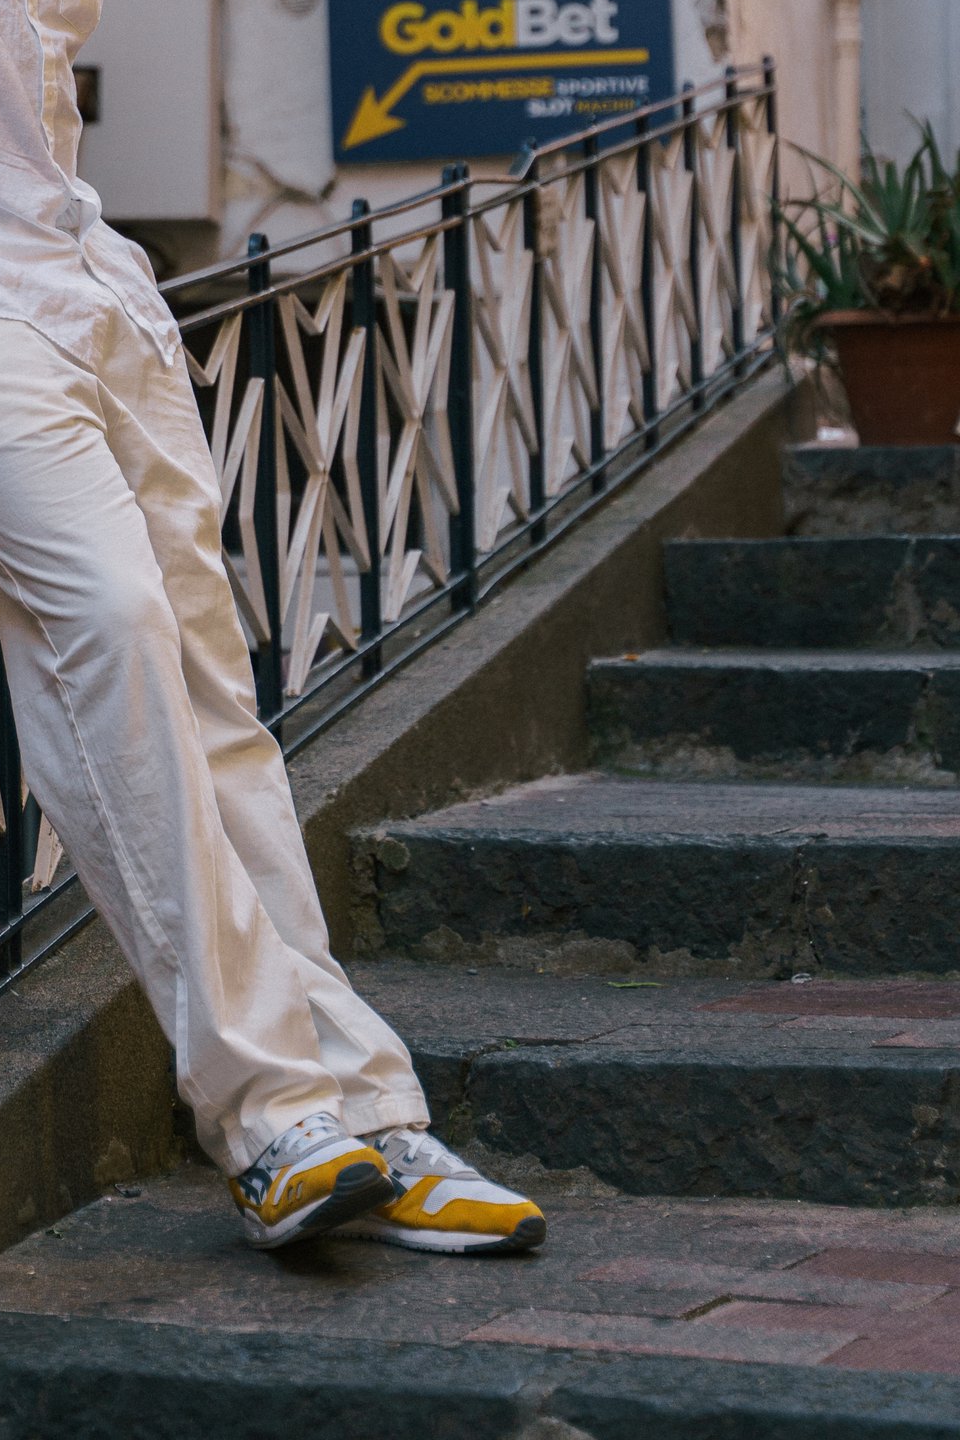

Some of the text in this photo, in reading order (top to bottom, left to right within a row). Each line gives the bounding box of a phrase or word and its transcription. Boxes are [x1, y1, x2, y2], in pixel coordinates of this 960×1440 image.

[424, 74, 650, 103] SCOMMESSE SPORTIVE
[527, 97, 573, 118] SLOT
